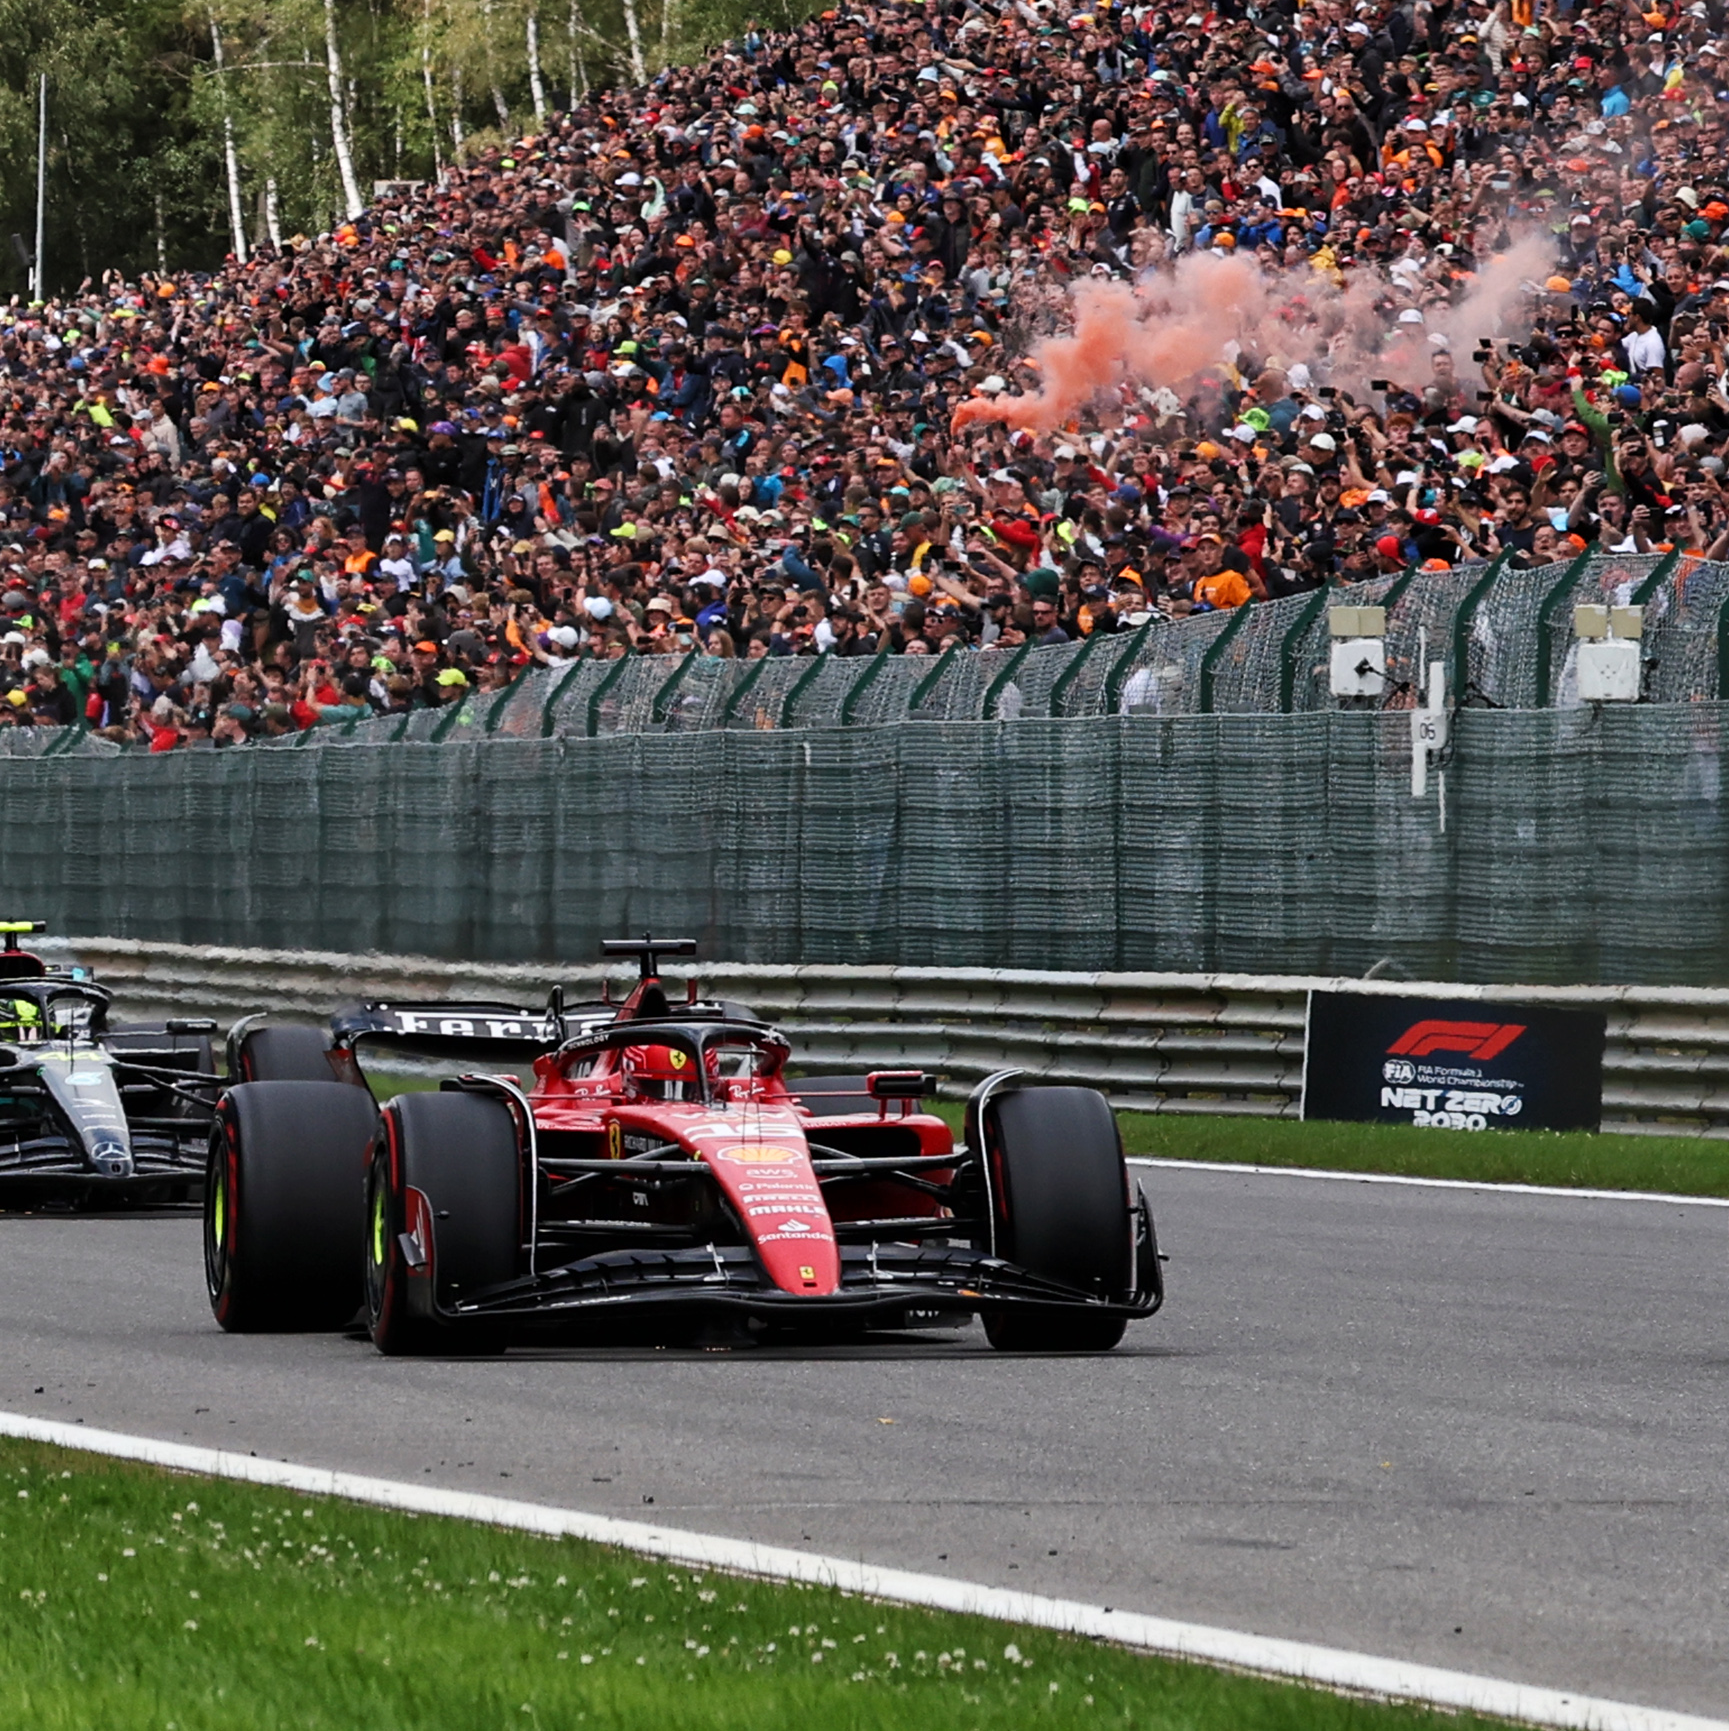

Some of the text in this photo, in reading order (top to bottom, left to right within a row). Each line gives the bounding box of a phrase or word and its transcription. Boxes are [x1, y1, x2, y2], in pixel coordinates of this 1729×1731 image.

[1385, 1019, 1527, 1061] F1
[34, 1052, 104, 1062] 44
[1384, 1063, 1413, 1081] FIA
[1417, 1065, 1433, 1074] FIA
[1434, 1066, 1477, 1076] Formula
[1417, 1075, 1446, 1085] World
[1381, 1087, 1523, 1116] NET ZERO
[1413, 1110, 1487, 1132] 2030
[683, 1123, 807, 1143] 16
[745, 1169, 795, 1177] aws
[757, 1231, 834, 1245] Santander
